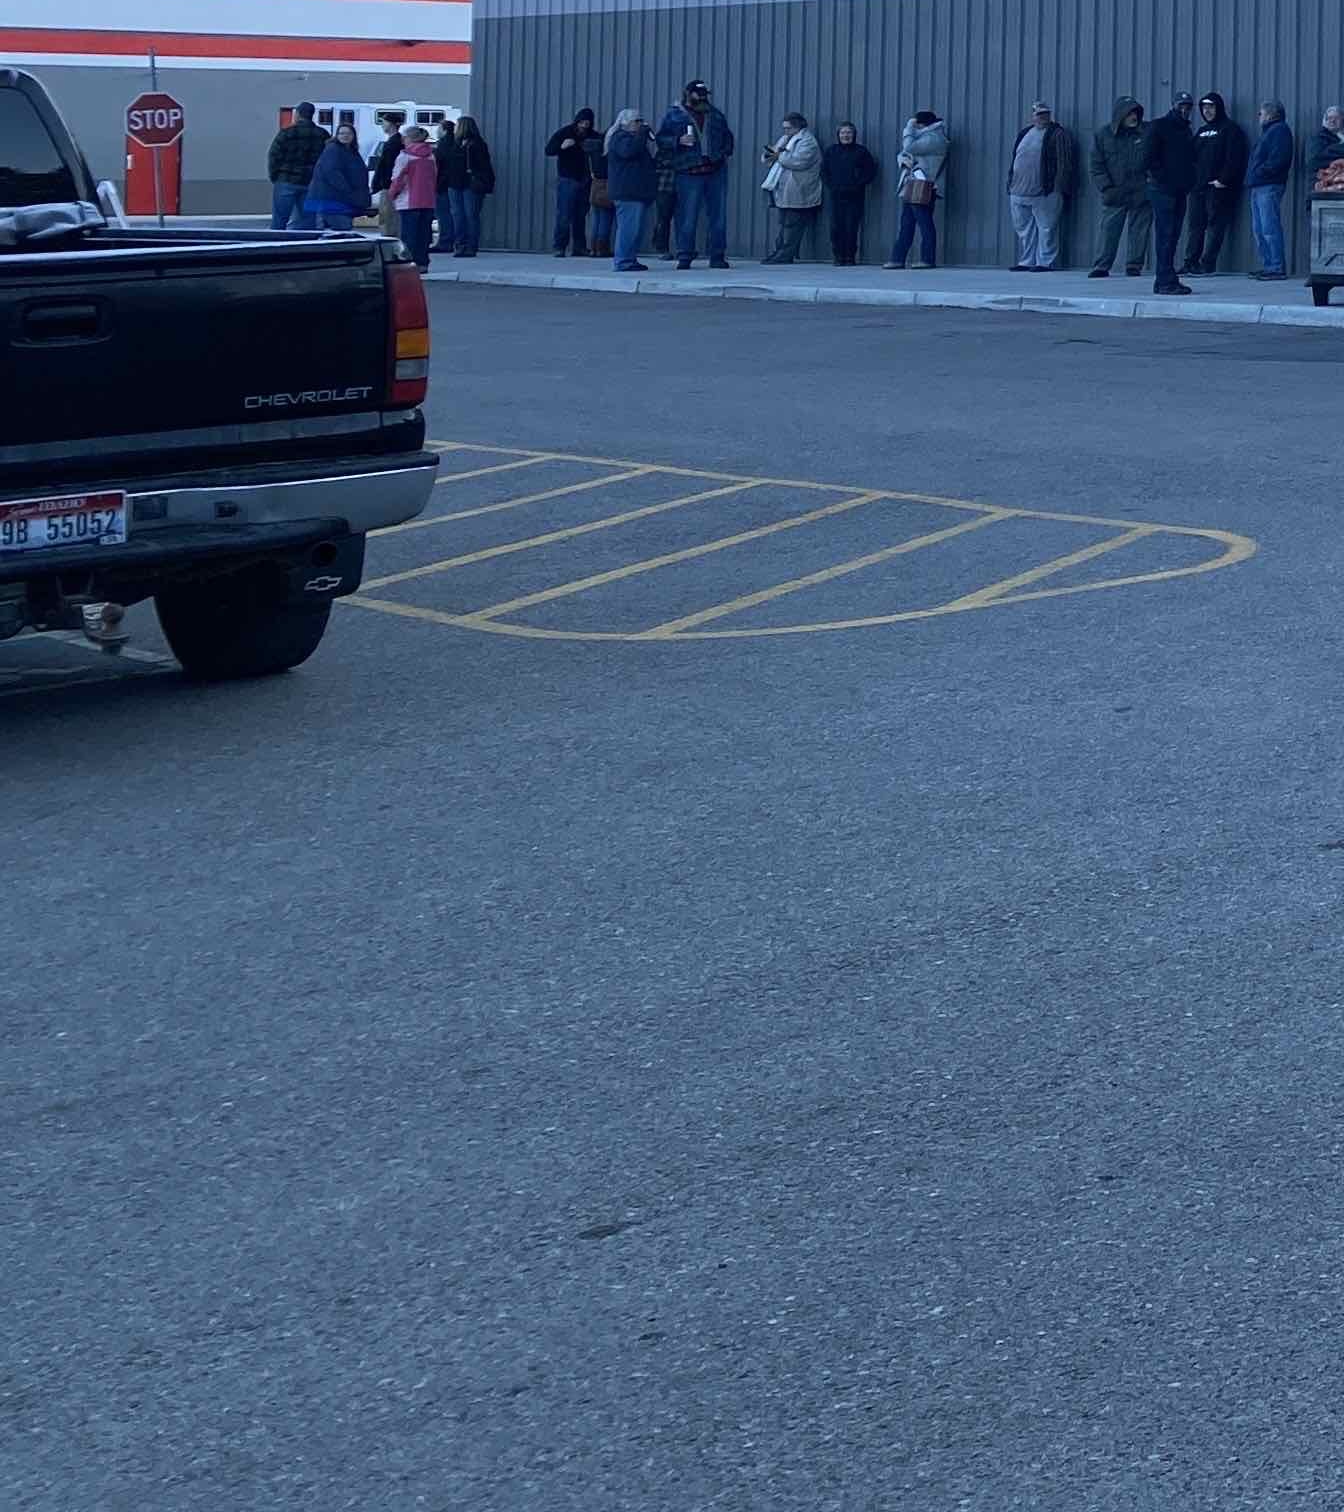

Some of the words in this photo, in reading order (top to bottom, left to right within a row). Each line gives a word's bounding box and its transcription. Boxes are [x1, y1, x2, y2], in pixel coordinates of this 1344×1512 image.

[129, 109, 182, 130] STOP
[244, 386, 373, 409] CHEVROLET
[2, 518, 28, 545] 9B
[47, 509, 117, 541] 55052
